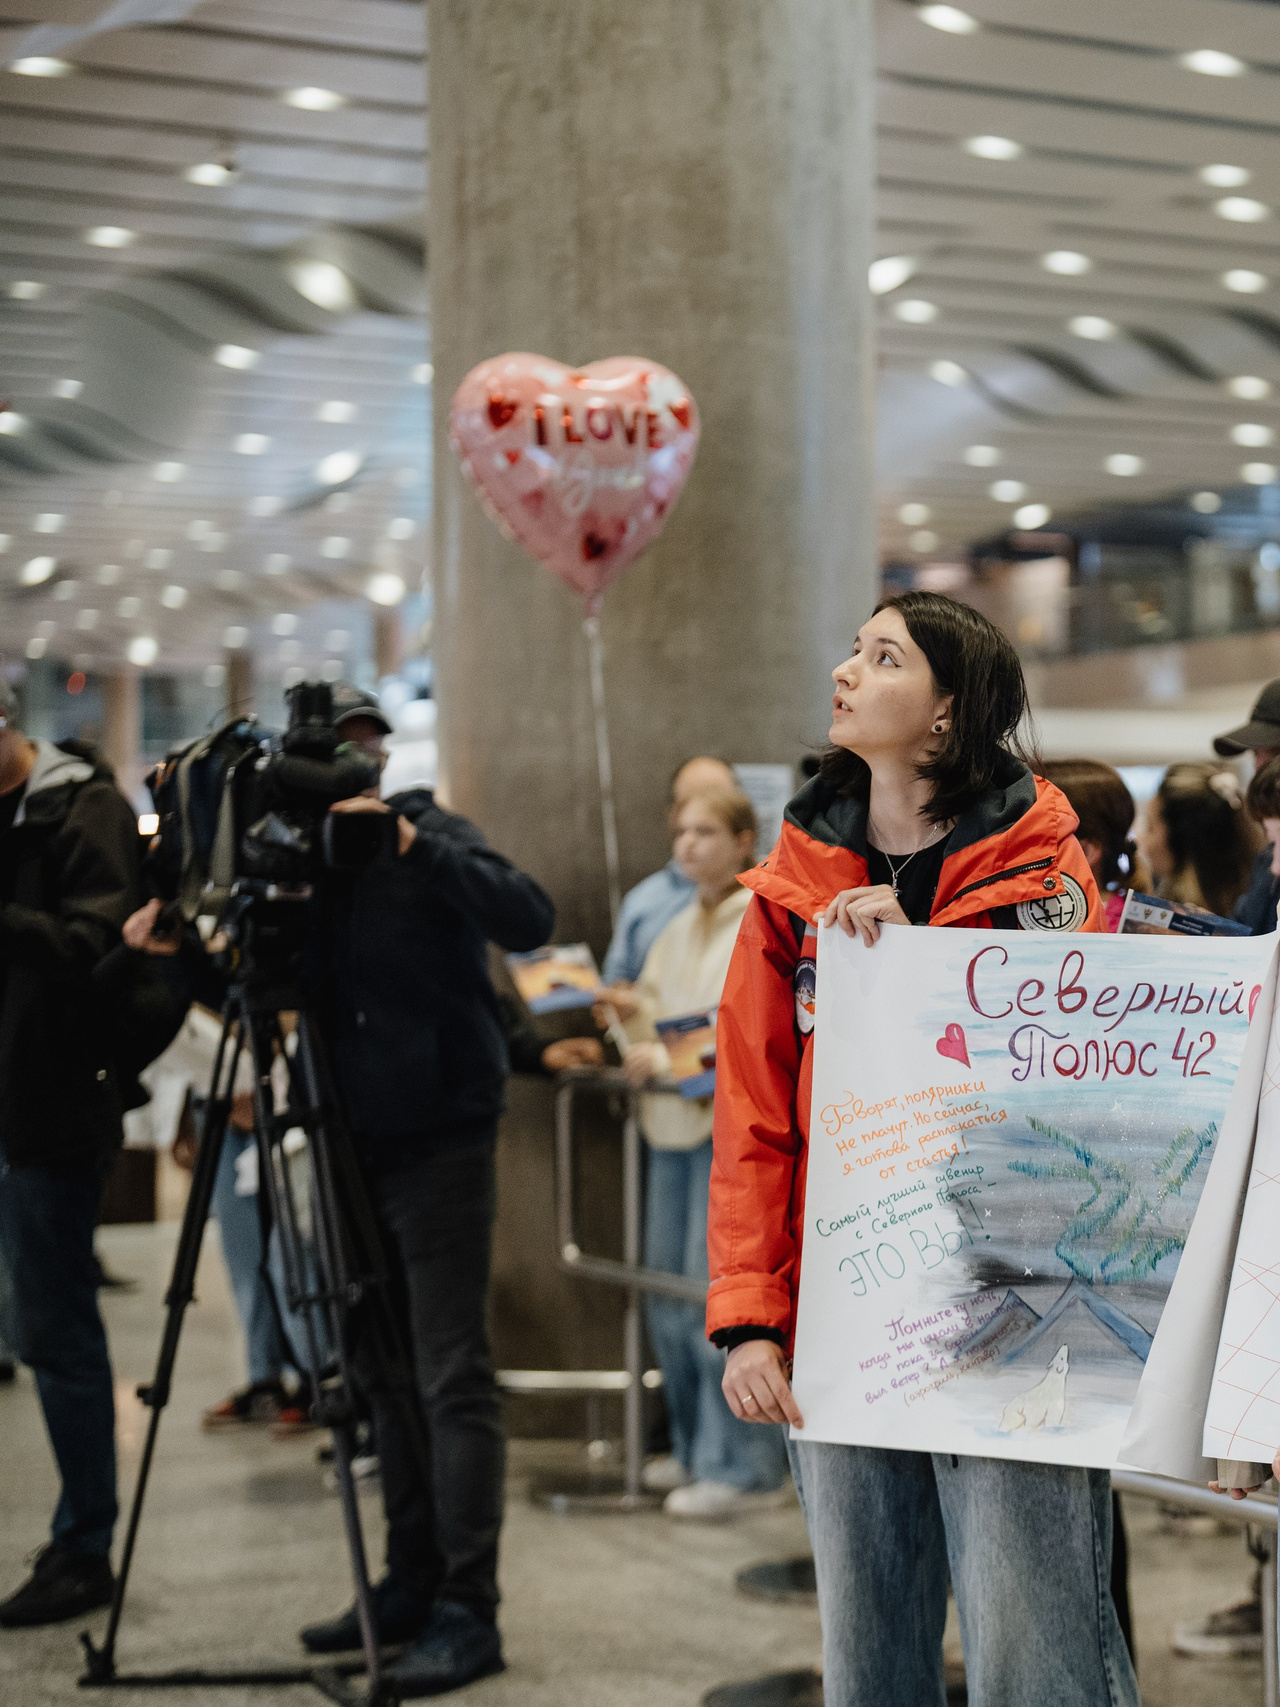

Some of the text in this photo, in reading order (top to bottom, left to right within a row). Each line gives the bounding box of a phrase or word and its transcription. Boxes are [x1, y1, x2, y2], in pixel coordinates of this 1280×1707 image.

[534, 404, 662, 449] I LOVE
[965, 945, 1245, 1032] Северный
[1008, 1023, 1217, 1082] Полюс 42
[820, 1080, 986, 1136] Говорят, полярники
[861, 1121, 913, 1144] плачут.
[934, 1100, 989, 1121] сейчас,
[856, 1140, 910, 1167] готова
[918, 1108, 1008, 1152] расплакаться
[906, 1134, 970, 1172] счастья!
[816, 1164, 984, 1237] Самый лучший сувенир
[871, 1203, 933, 1234] Северного
[838, 1199, 991, 1297] ЭТО ВЫ!
[884, 1308, 952, 1342] Помните
[858, 1352, 892, 1372] когда
[896, 1340, 915, 1354] мы
[896, 1354, 925, 1372] пока
